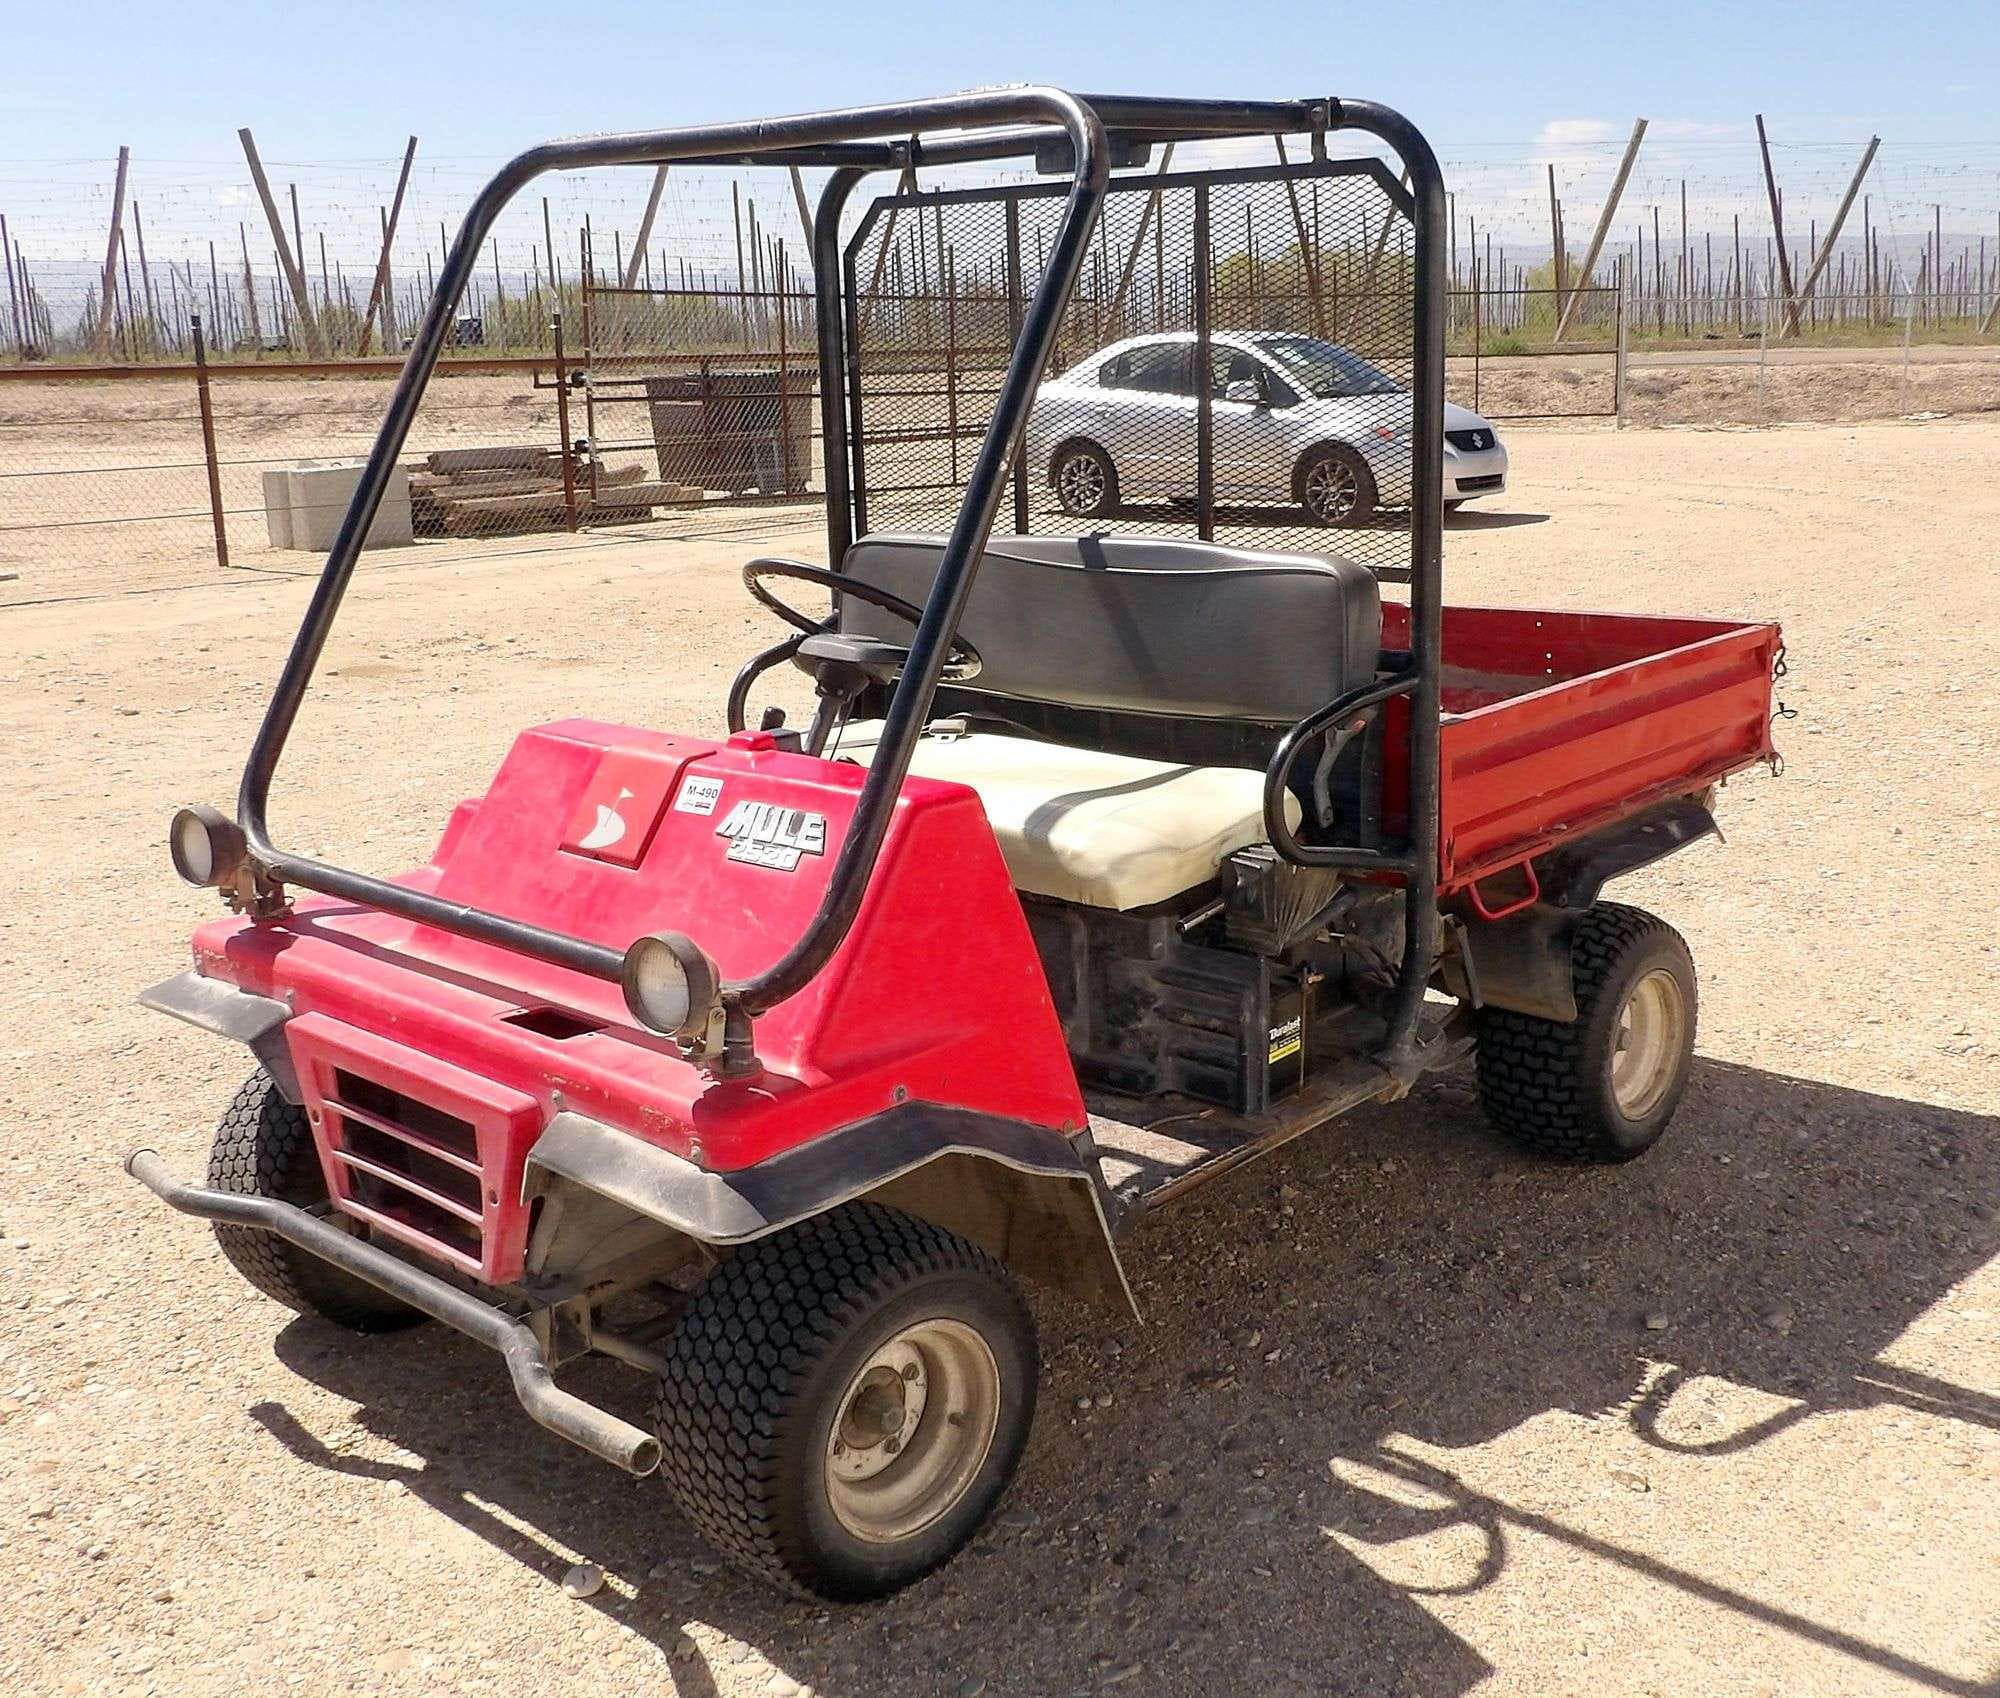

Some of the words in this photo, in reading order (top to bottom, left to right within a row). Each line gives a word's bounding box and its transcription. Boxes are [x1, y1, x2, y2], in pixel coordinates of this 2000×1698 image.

[687, 785, 718, 799] M-490
[715, 800, 826, 854] MULE
[1269, 1015, 1301, 1041] Duralast
